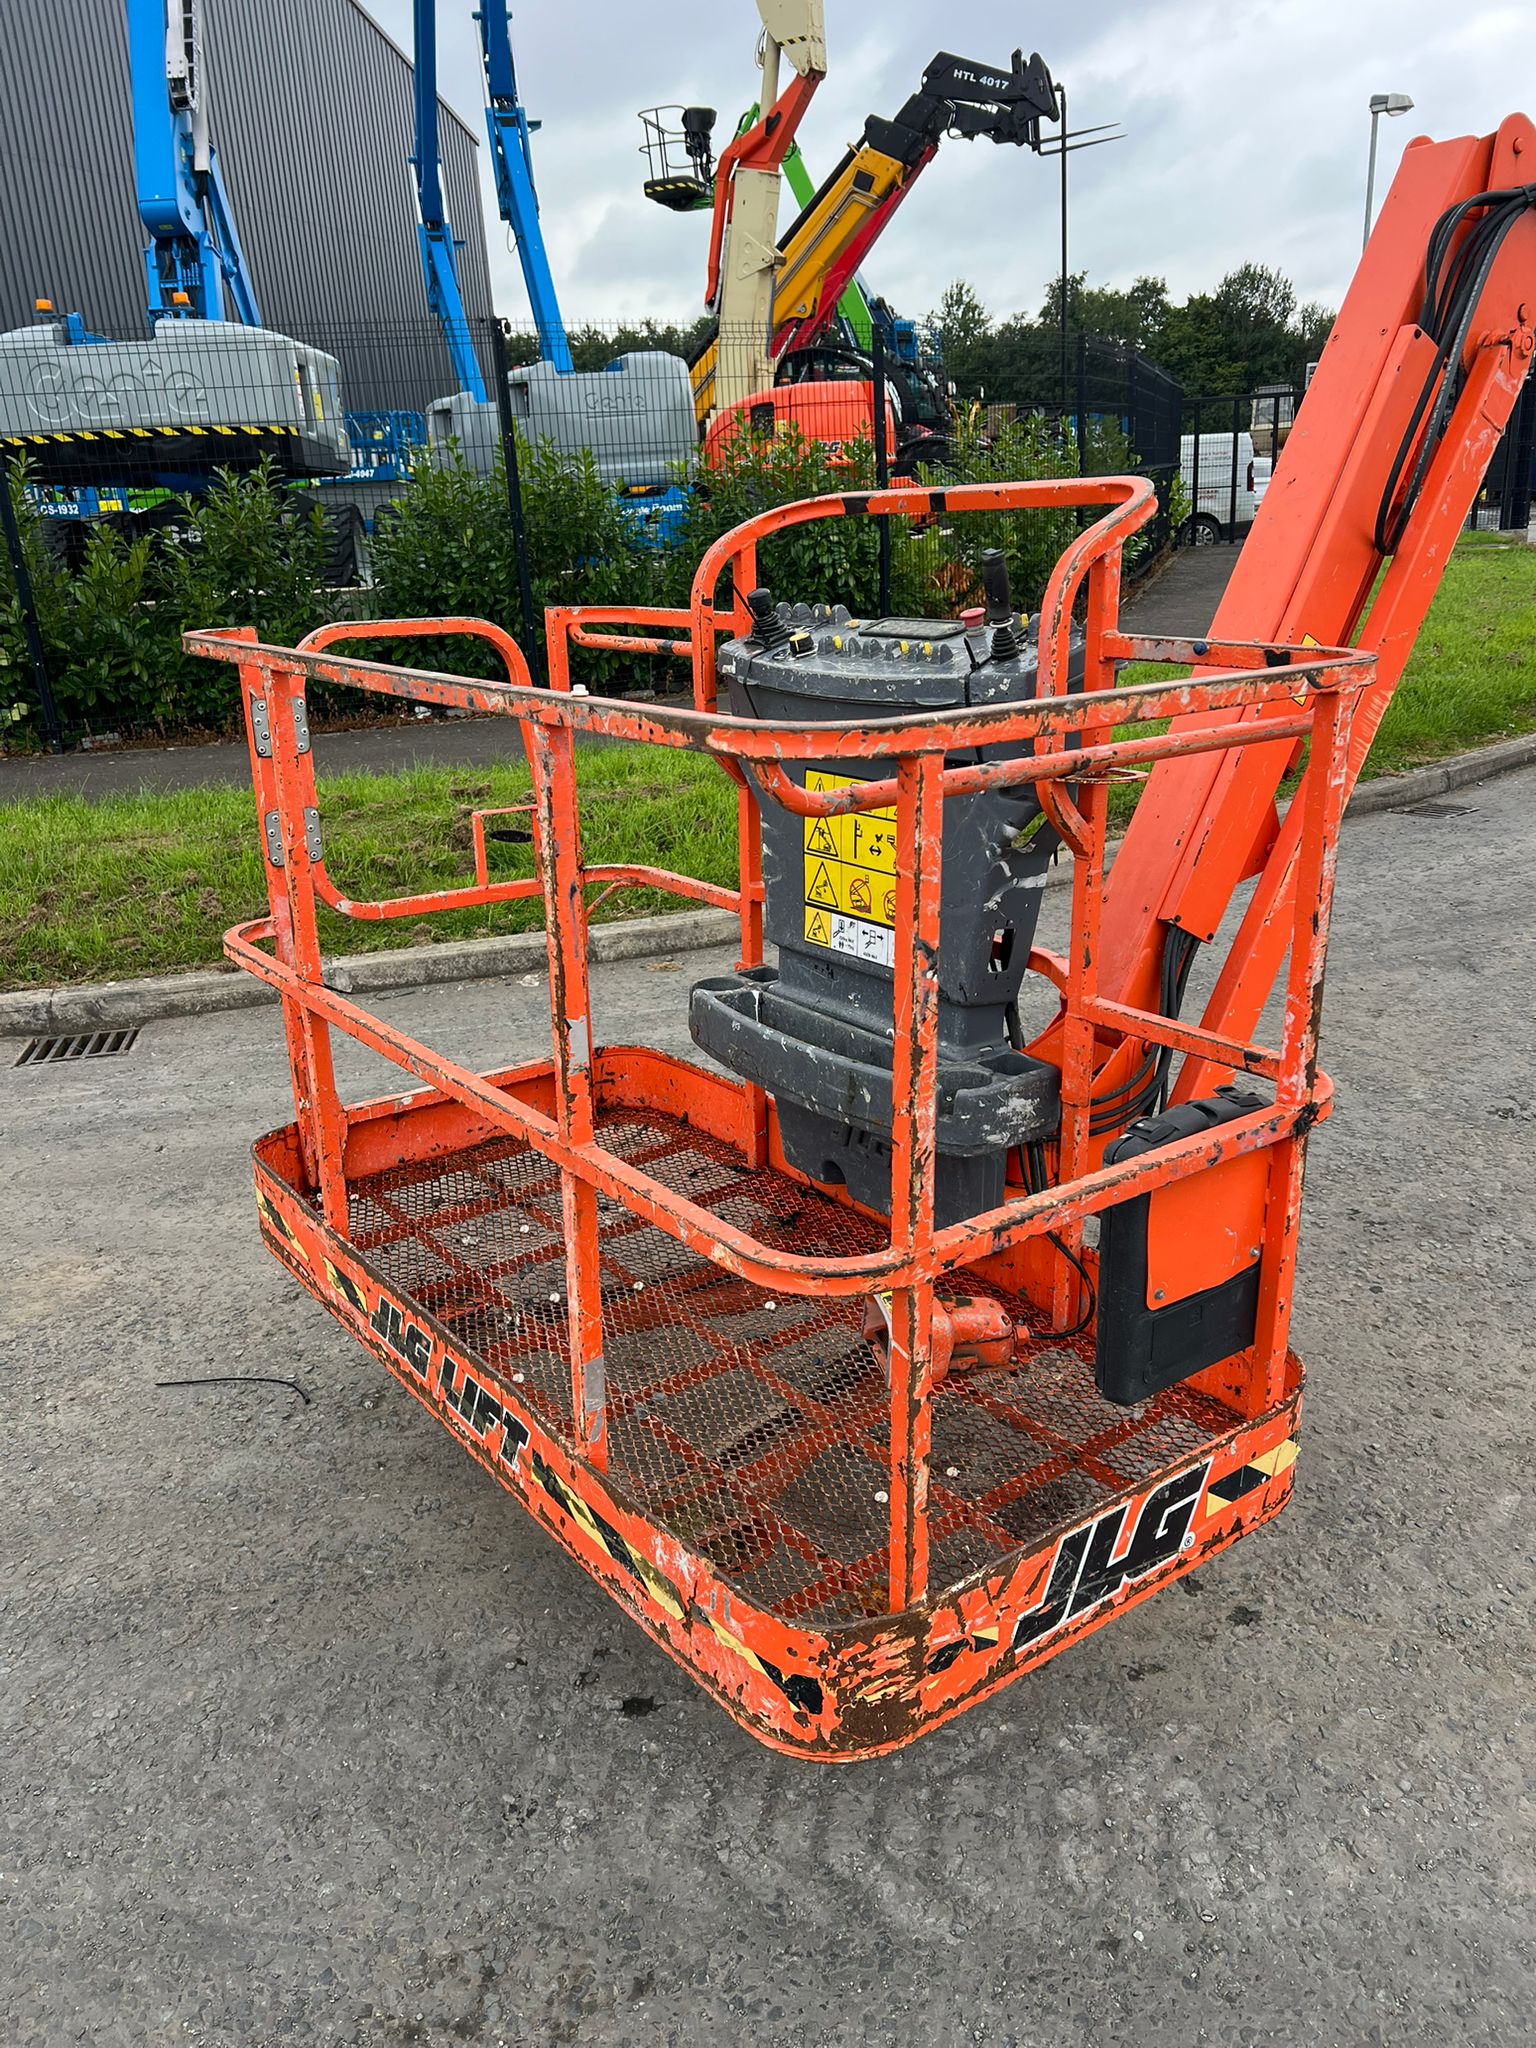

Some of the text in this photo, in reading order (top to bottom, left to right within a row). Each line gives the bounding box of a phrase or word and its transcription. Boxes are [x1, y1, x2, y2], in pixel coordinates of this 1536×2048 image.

[953, 68, 1010, 90] HTL 4017
[25, 358, 209, 423] Genie
[370, 1296, 531, 1470] JLG LIFT
[1012, 1457, 1213, 1654] JLG
